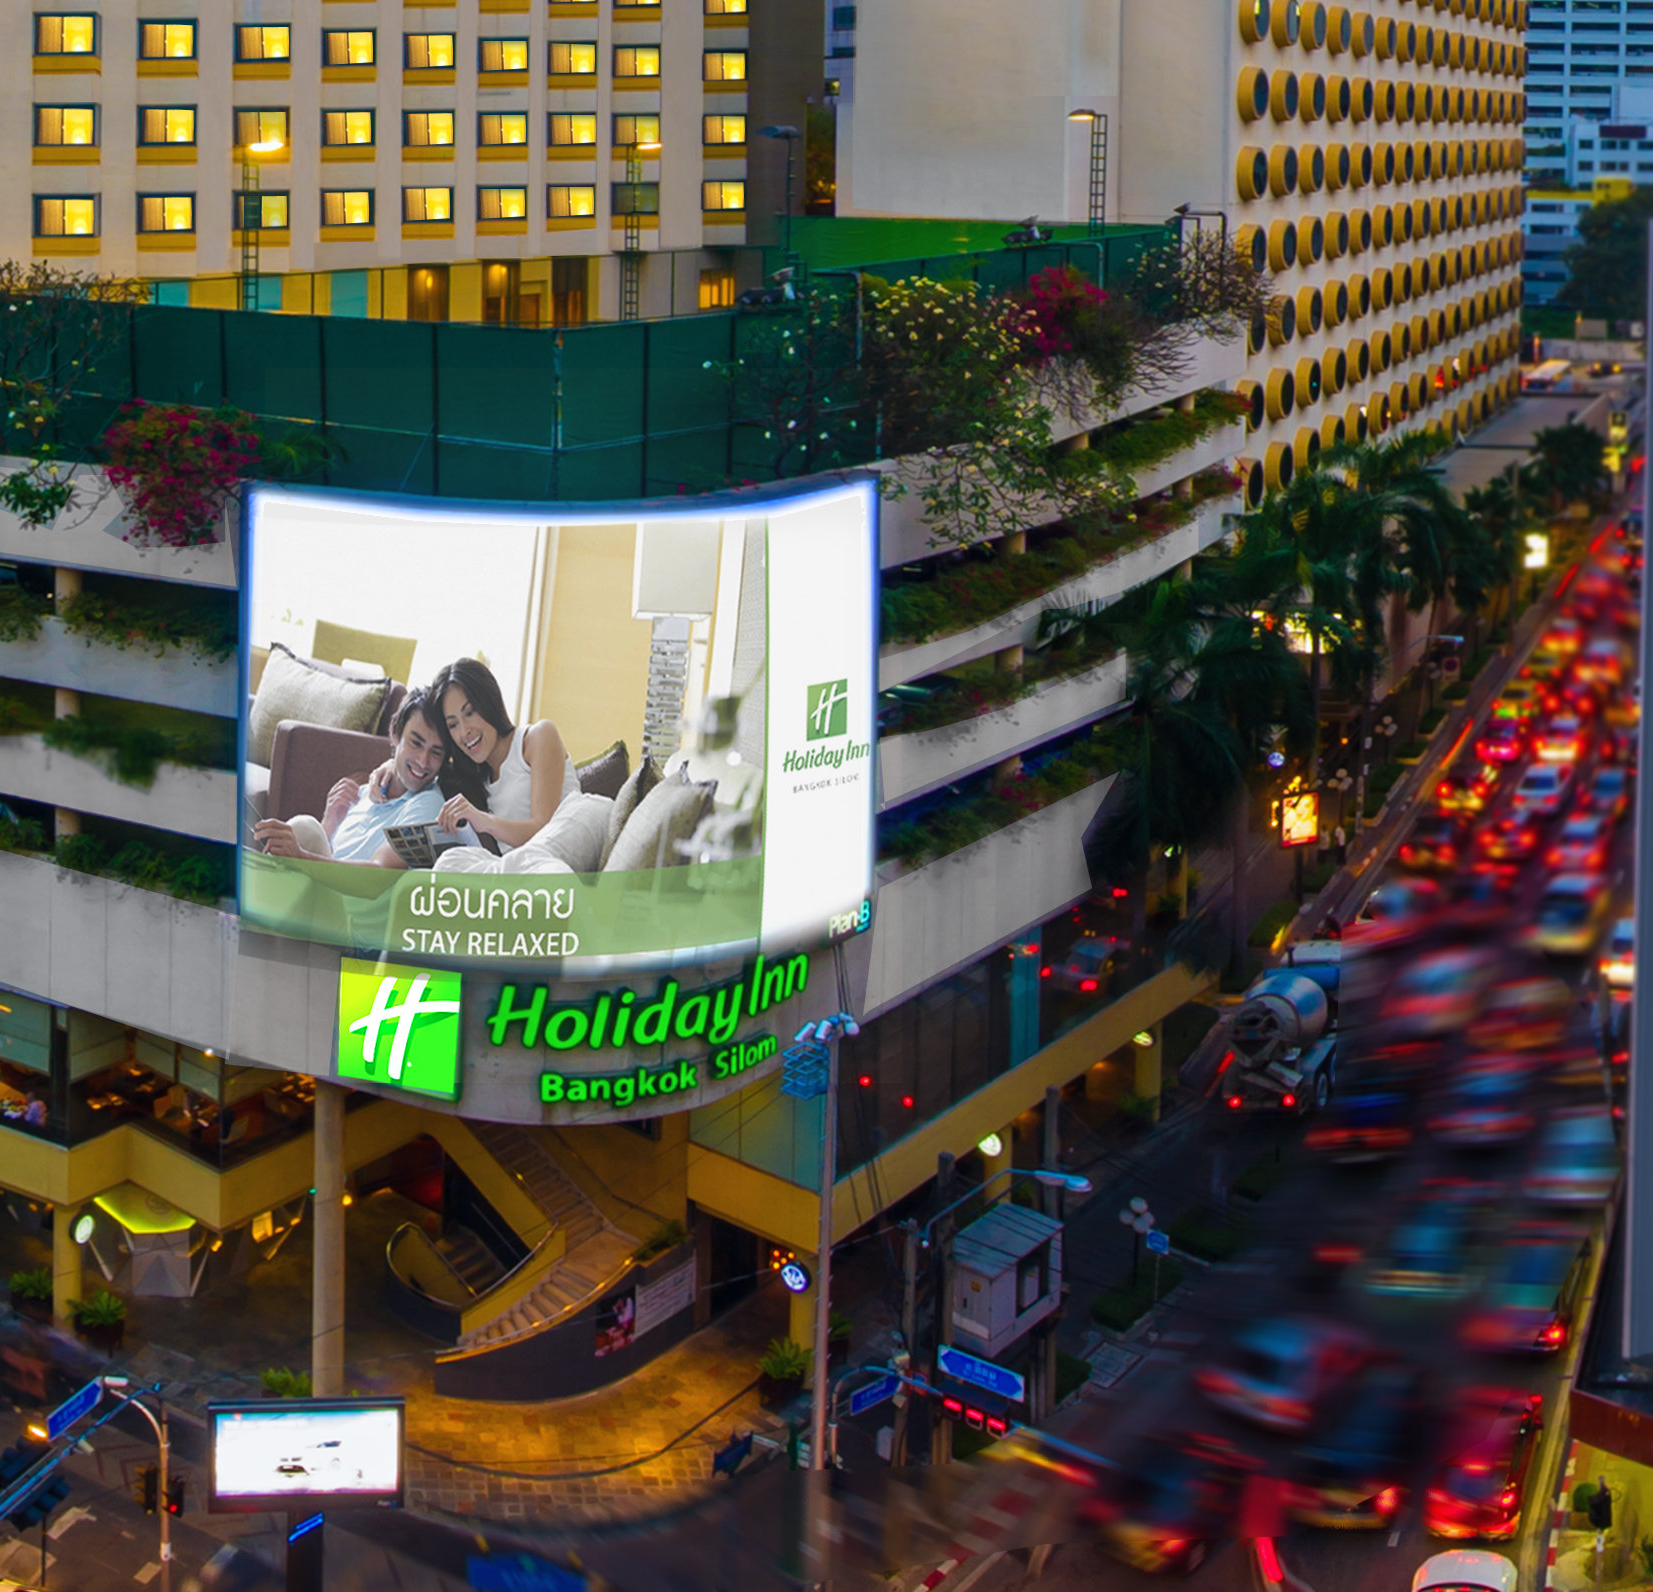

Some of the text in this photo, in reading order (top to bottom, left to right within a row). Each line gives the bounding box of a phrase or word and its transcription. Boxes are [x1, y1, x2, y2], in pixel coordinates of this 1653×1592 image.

[782, 739, 870, 772] Holiday Inn
[410, 873, 574, 919] ผ่อนคลาย
[402, 928, 579, 956] STAY RELAXED
[487, 953, 809, 1050] Holiday Inn
[540, 1033, 778, 1107] Bangkok Silom
